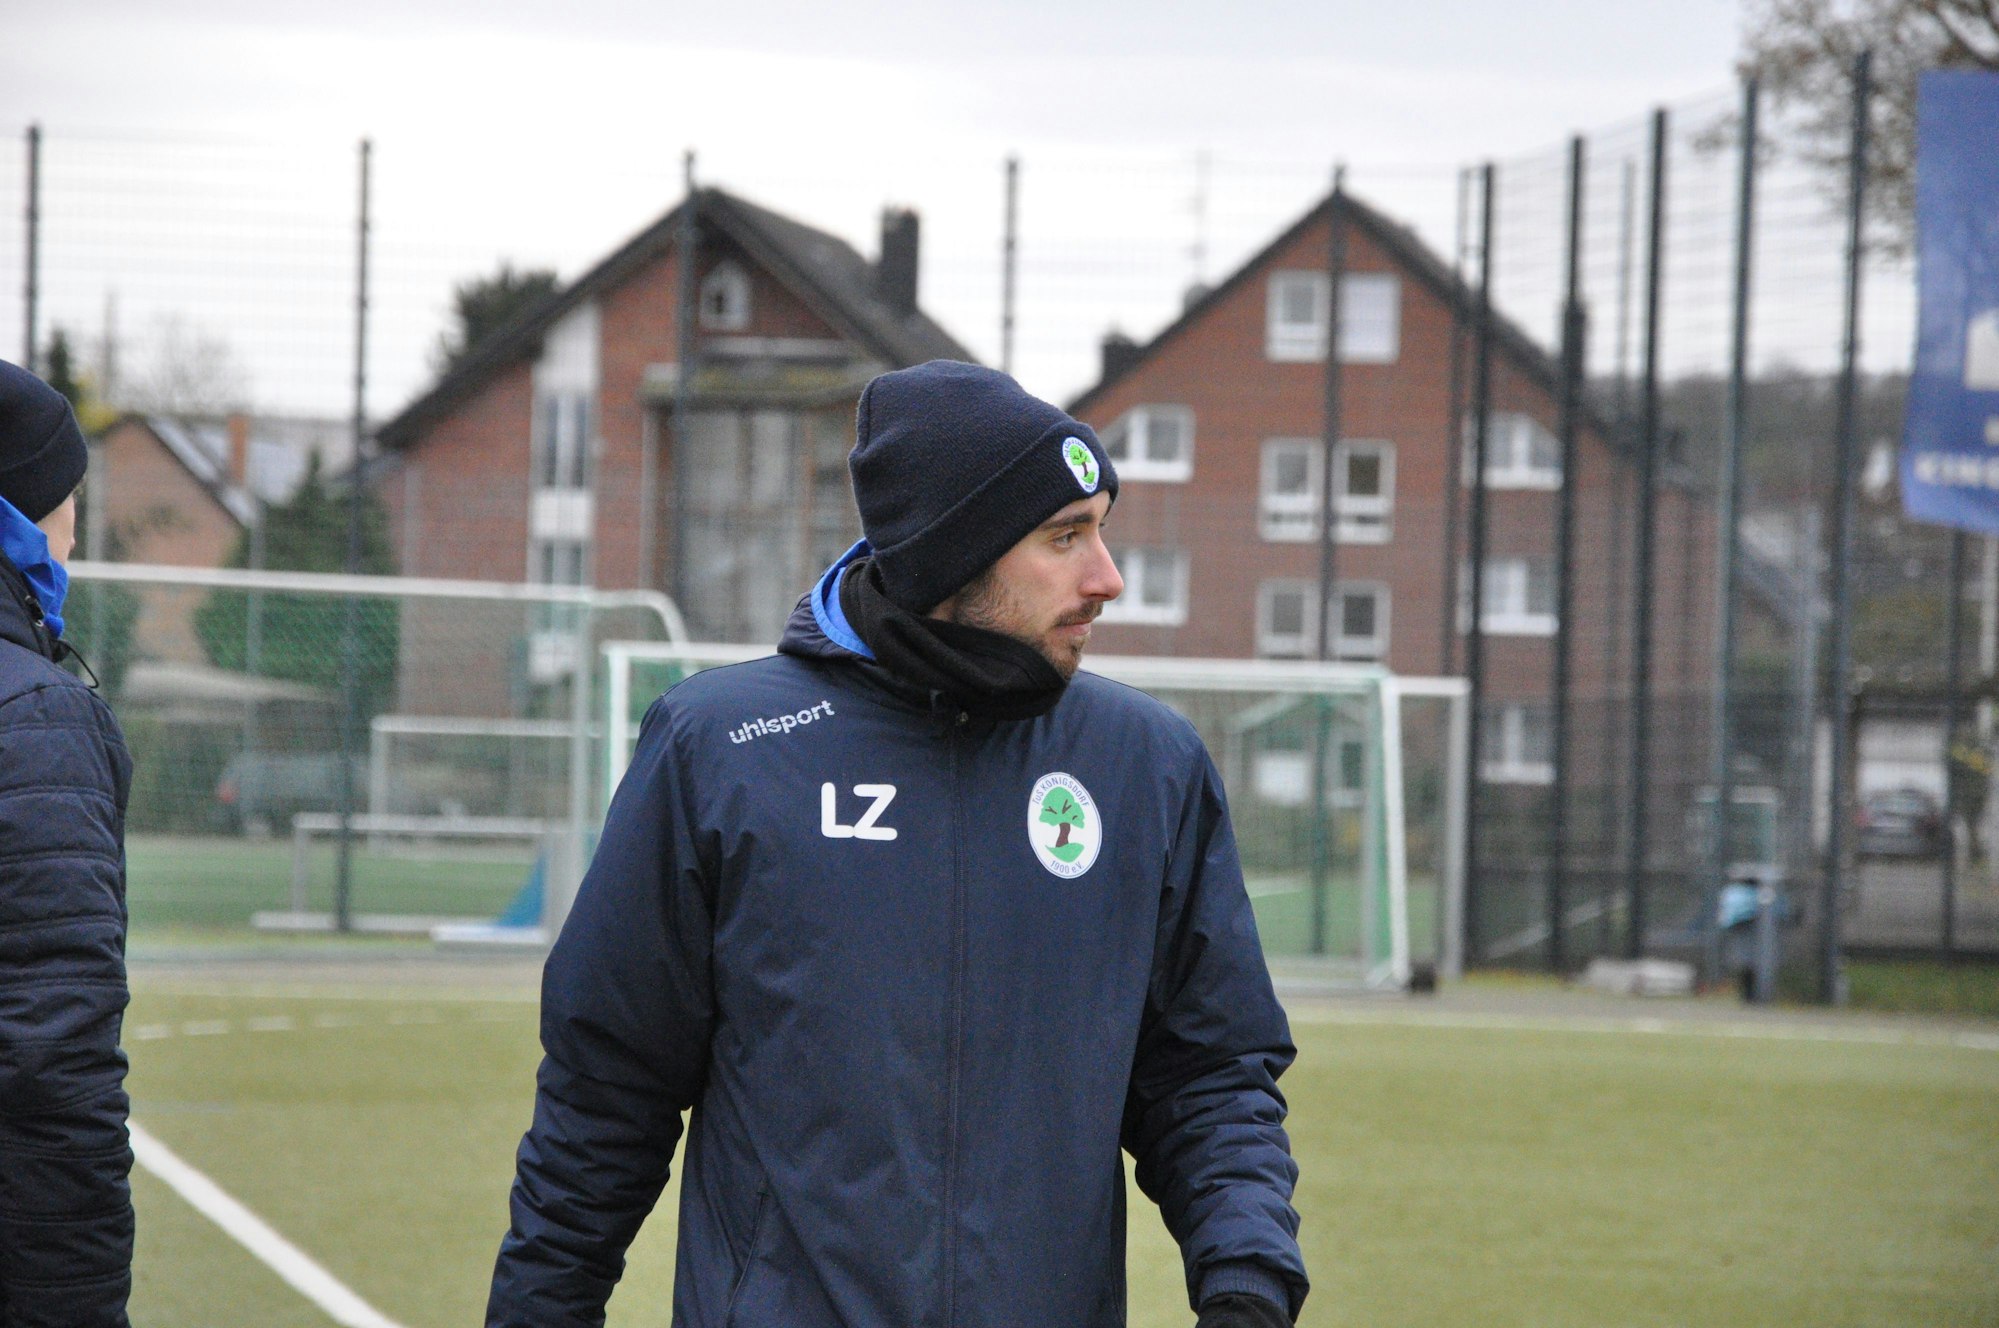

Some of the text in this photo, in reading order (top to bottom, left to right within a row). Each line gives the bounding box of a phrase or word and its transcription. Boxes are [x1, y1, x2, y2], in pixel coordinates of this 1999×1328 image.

[728, 700, 835, 744] uhlsport
[821, 782, 898, 841] LZ
[1050, 860, 1084, 874] 1900 e.V.
